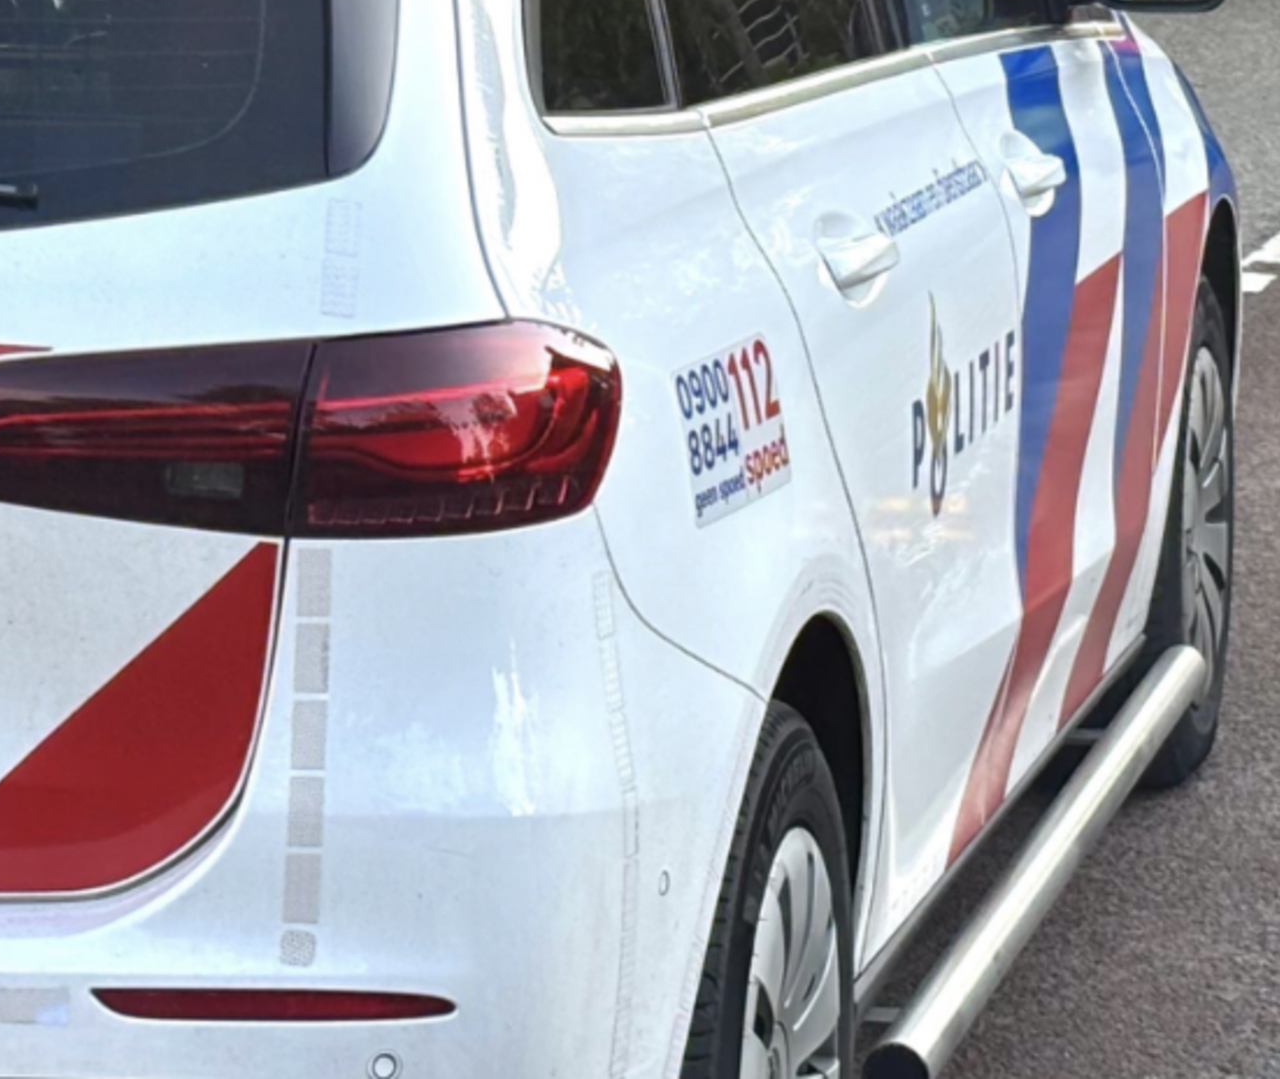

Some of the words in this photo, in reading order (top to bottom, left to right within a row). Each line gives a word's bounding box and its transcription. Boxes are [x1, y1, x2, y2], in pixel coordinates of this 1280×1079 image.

[675, 359, 729, 420] 0900
[727, 339, 781, 431] 112
[688, 413, 739, 476] 8844
[745, 424, 790, 495] spoed
[912, 329, 1016, 520] POLITIE
